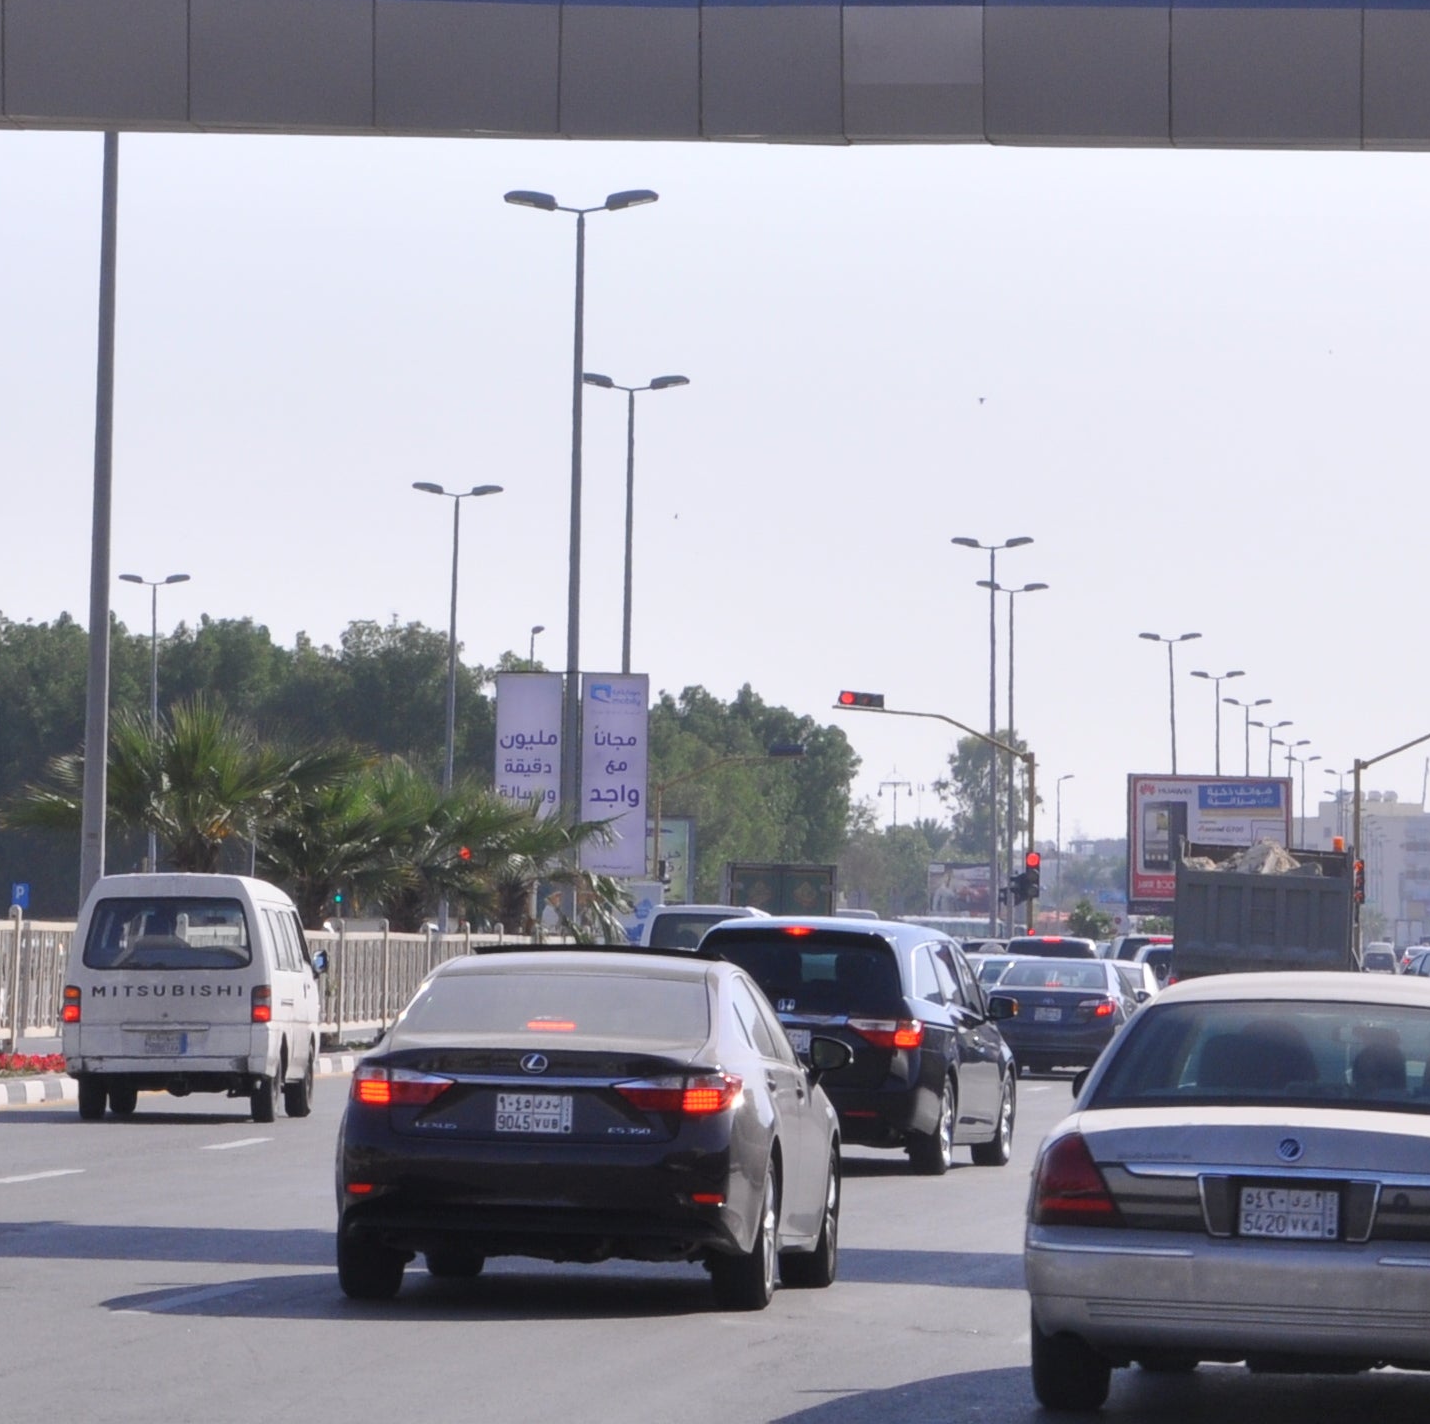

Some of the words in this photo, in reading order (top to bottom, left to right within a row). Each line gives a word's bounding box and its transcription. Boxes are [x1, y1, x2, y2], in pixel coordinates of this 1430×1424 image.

[499, 730, 558, 751] مليون
[504, 758, 552, 777] دقيقة
[605, 759, 628, 775] مع
[589, 784, 640, 808] واجد
[91, 984, 244, 998] MITSUBISHI
[497, 1114, 531, 1130] 9045
[1243, 1213, 1286, 1234] 5420
